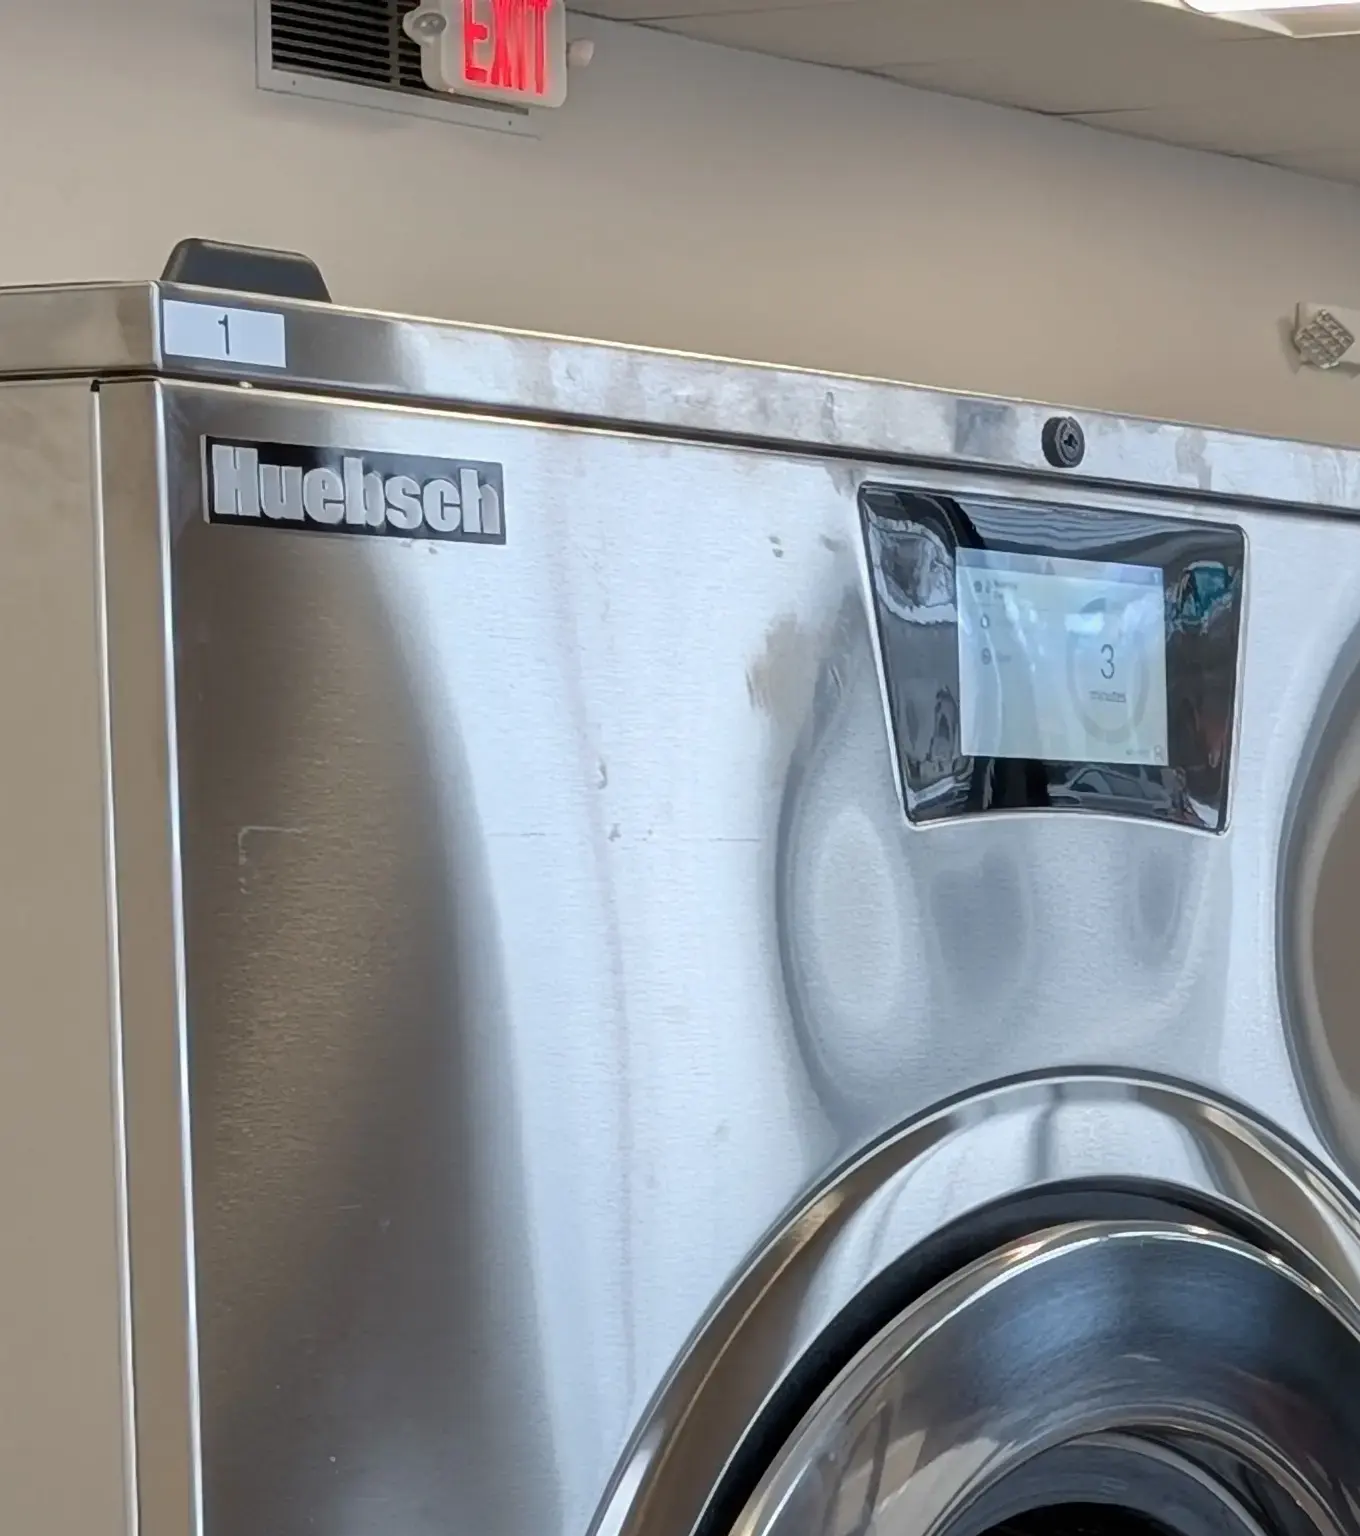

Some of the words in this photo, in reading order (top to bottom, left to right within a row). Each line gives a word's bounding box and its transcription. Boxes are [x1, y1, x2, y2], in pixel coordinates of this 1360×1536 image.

[463, 0, 549, 94] EXIT
[218, 313, 230, 355] 1
[211, 443, 500, 534] Huebsch
[1100, 643, 1115, 680] 3
